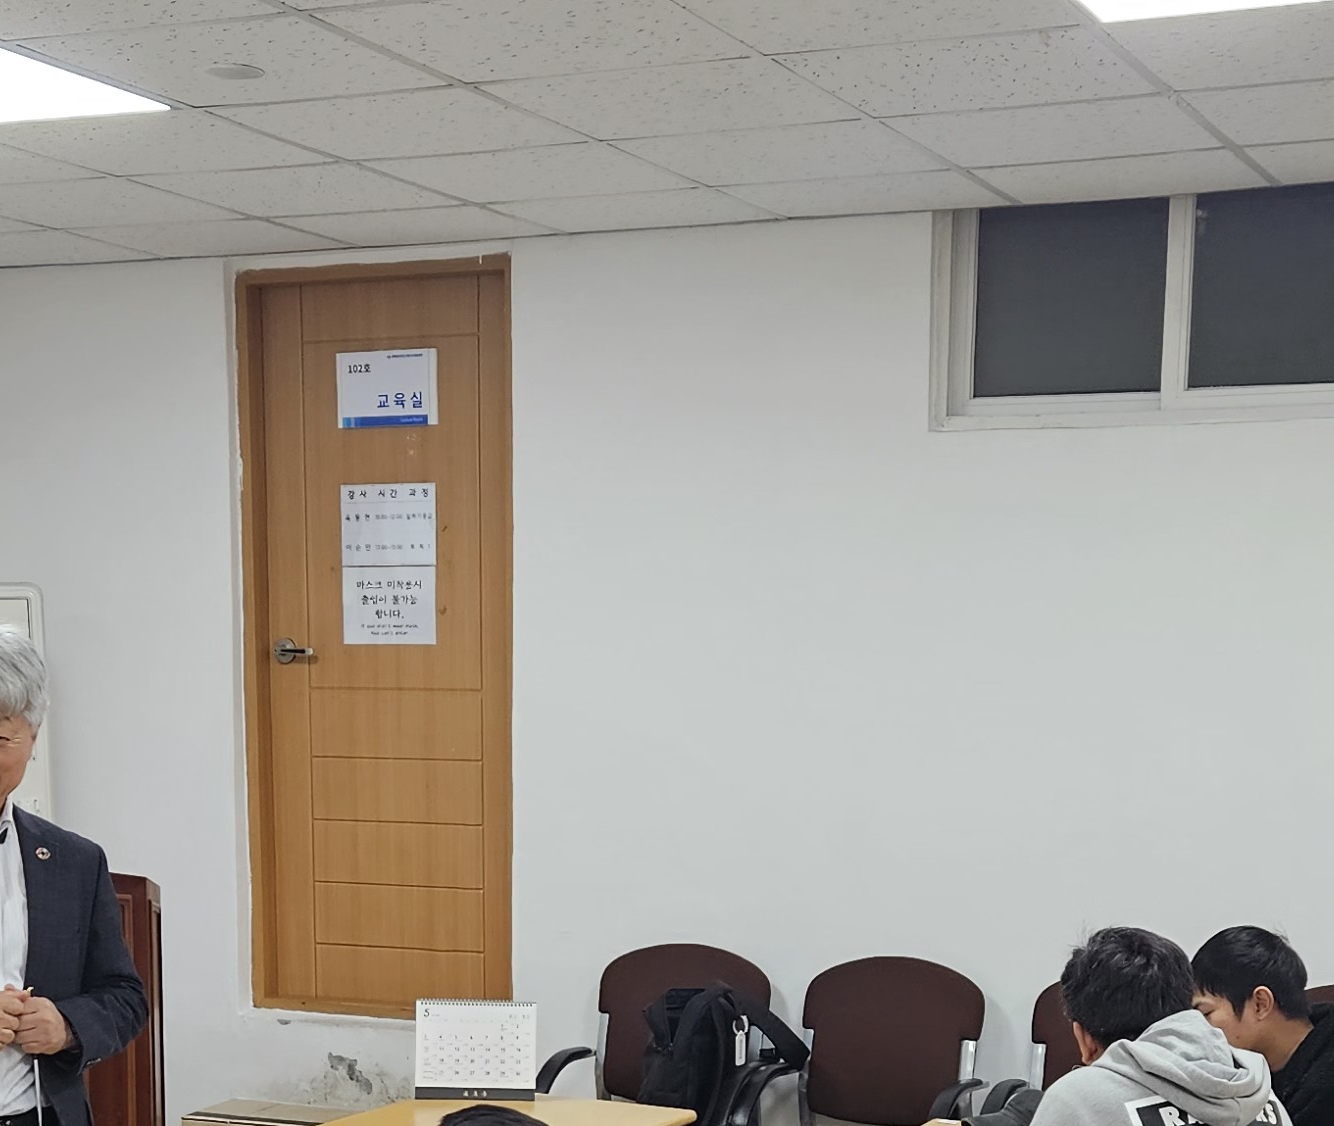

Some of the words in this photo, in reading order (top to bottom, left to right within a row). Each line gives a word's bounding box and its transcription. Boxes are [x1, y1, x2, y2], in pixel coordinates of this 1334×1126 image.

[348, 363, 371, 374] 102호
[377, 391, 423, 409] 교육실
[356, 580, 383, 590] 마스크
[423, 1008, 430, 1018] 5
